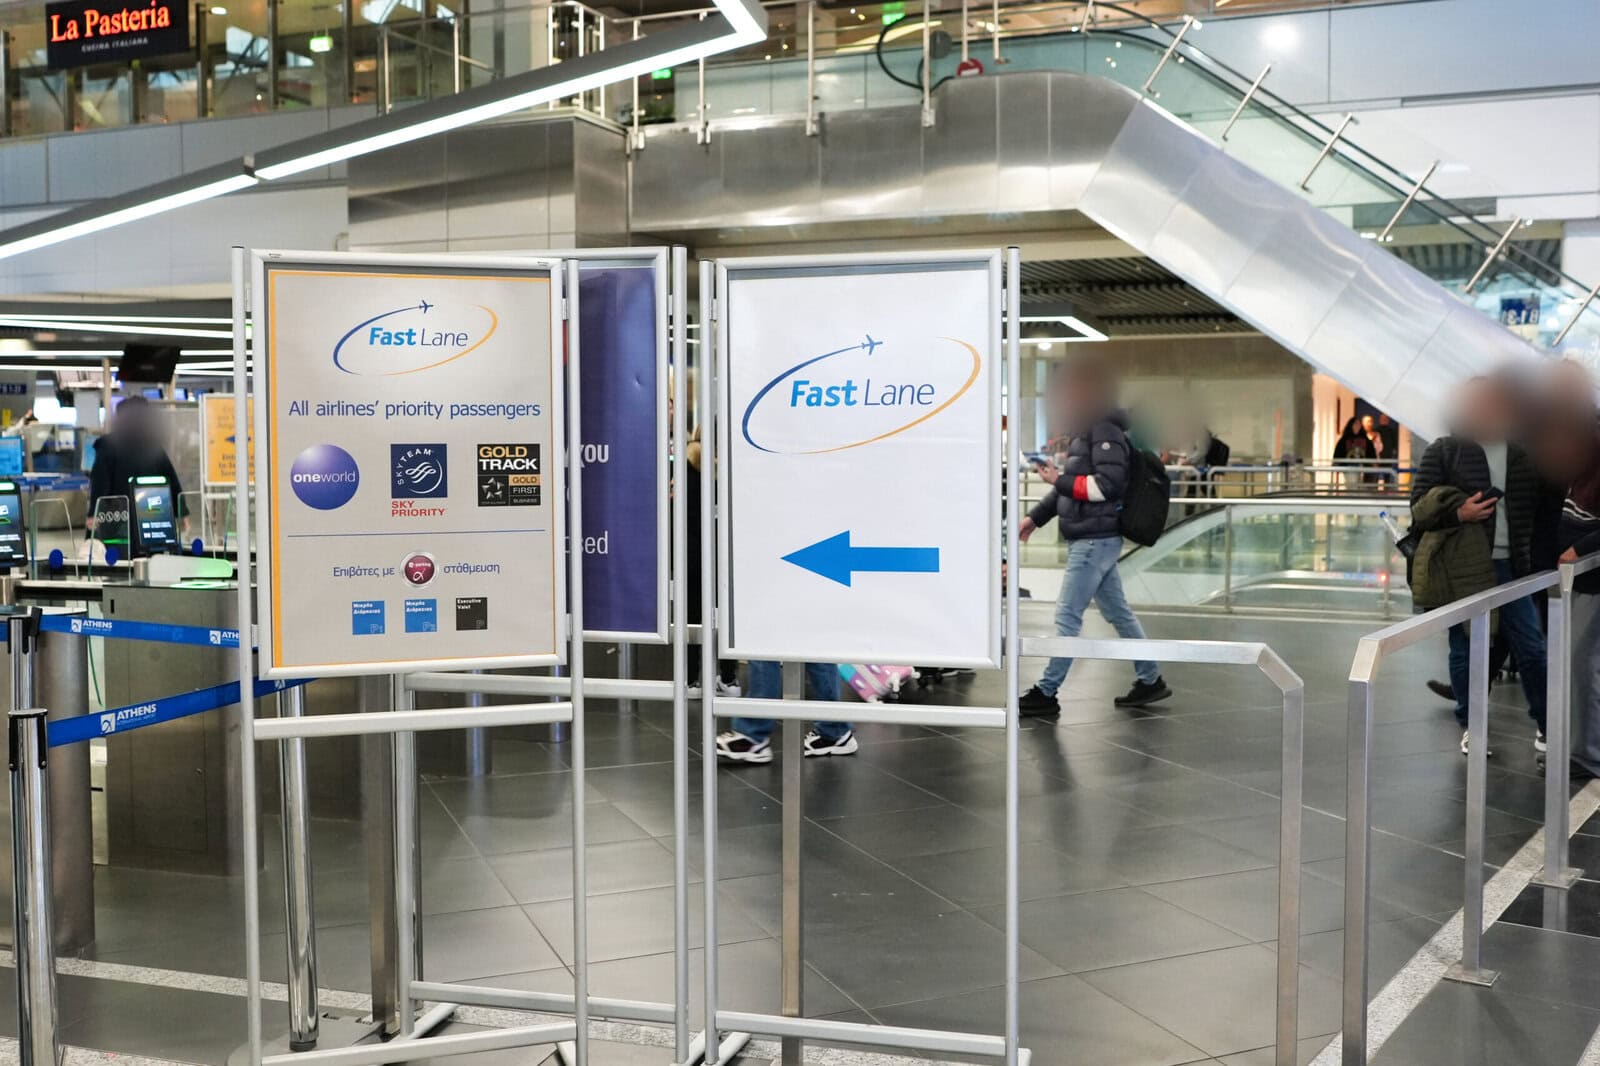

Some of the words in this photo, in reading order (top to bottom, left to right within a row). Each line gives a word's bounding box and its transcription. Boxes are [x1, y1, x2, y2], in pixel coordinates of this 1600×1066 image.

[51, 14, 79, 42] La
[84, 0, 170, 38] Pasteria
[369, 327, 416, 346] Fast
[420, 328, 469, 347] Lane
[790, 379, 858, 408] Fast
[864, 378, 936, 407] Lane
[288, 400, 309, 417] All
[385, 400, 444, 420] priority
[450, 402, 541, 420] passengers
[479, 446, 528, 458] GOLD
[396, 448, 432, 485] SKYTEAM
[479, 458, 538, 471] TRACK
[293, 471, 356, 483] oneworld
[512, 476, 538, 484] GOLD
[391, 500, 415, 509] SKY
[391, 508, 445, 517] PRIORITY
[333, 565, 380, 578] Επιβάτες
[382, 567, 395, 578] με
[443, 563, 500, 575] στάθμευση
[83, 620, 113, 630] ATHENS
[116, 703, 157, 721] ATHENS
